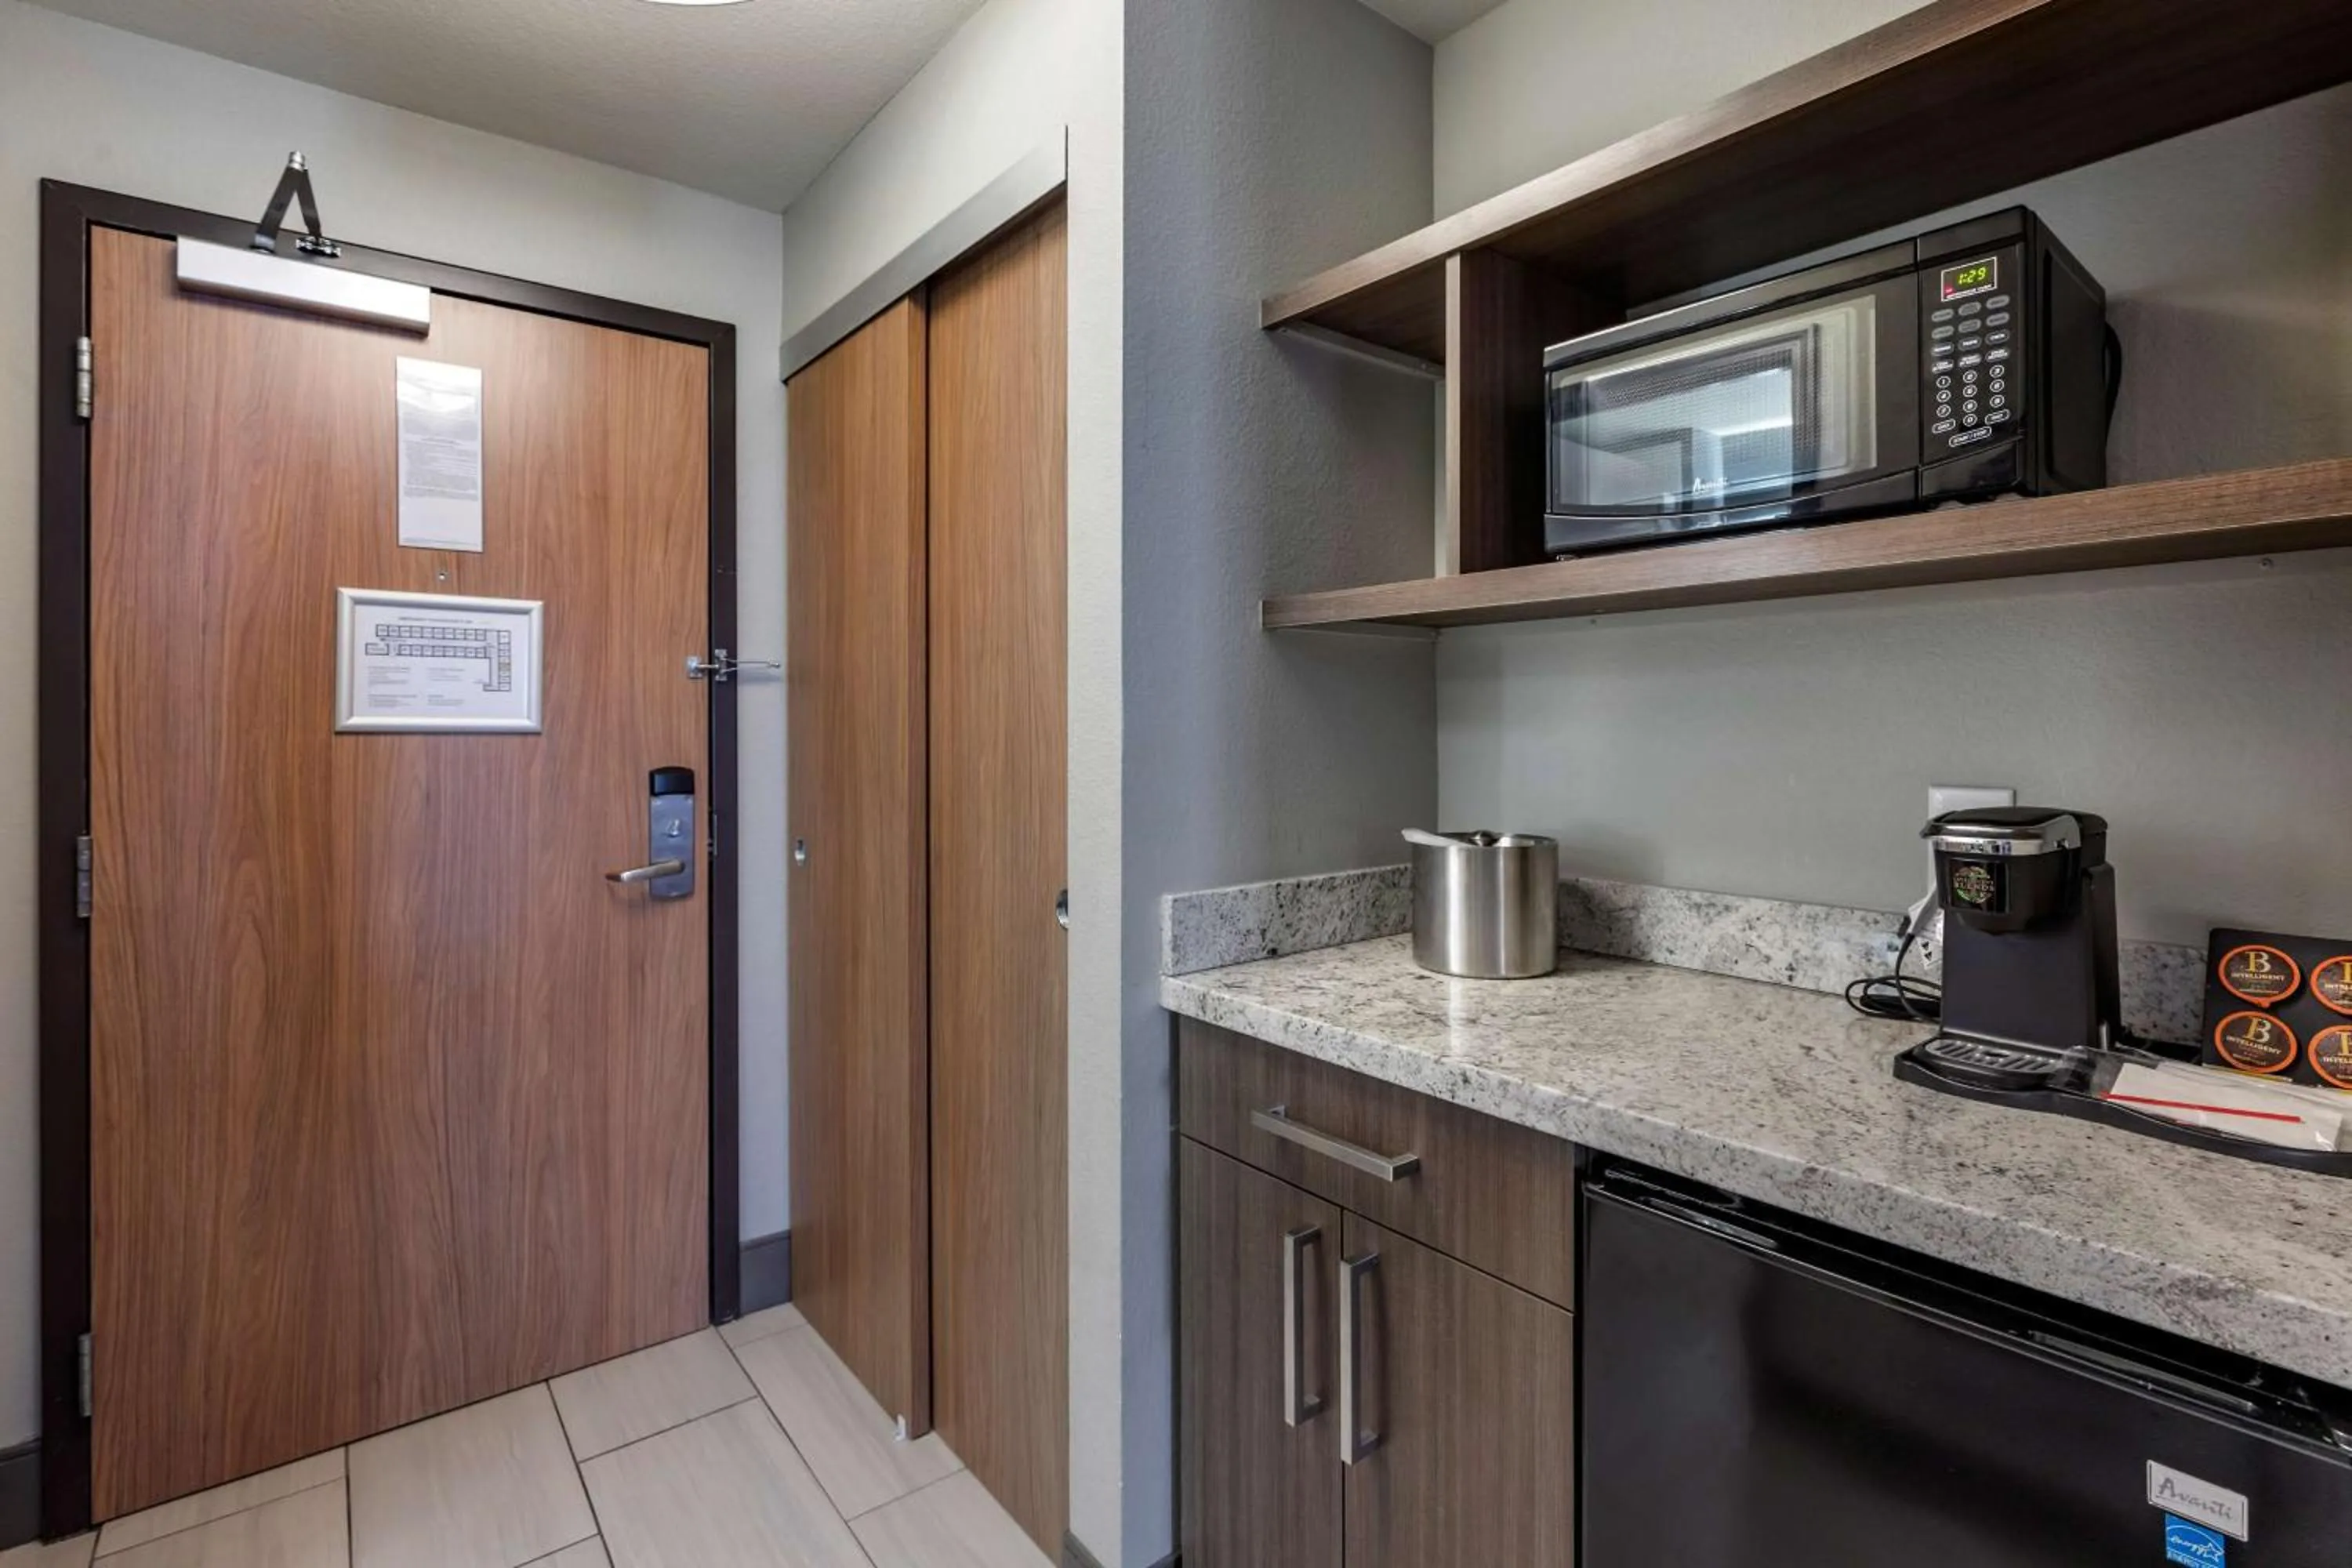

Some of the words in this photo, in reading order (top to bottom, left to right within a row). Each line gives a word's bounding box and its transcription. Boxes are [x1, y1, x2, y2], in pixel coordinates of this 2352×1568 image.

[1958, 267, 1987, 285] 1:29
[2245, 951, 2271, 973] B
[2231, 972, 2285, 982] INTELLIGENT
[2242, 1016, 2272, 1042] B
[2226, 1035, 2282, 1054] INTELLIGENT
[2157, 1477, 2233, 1520] Avanti
